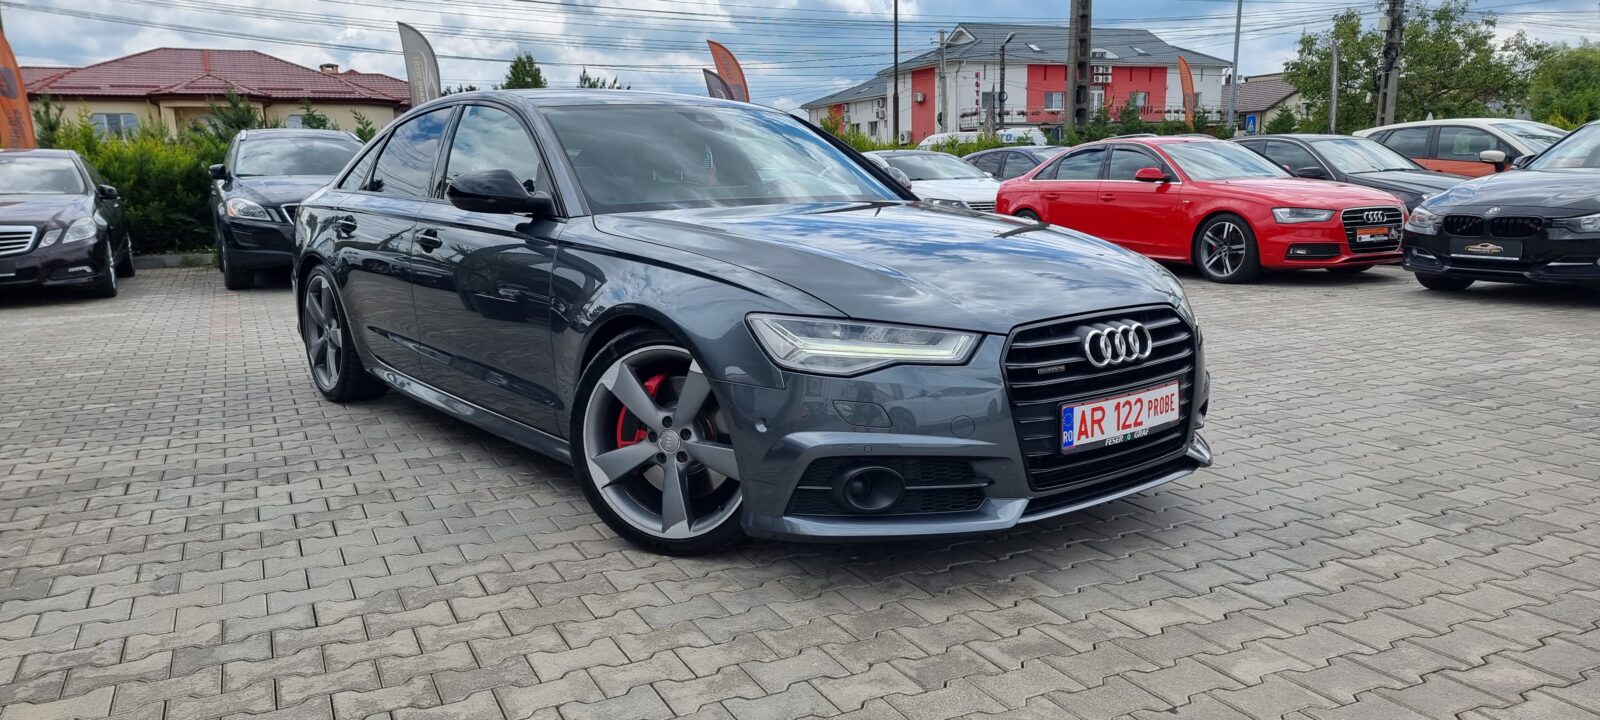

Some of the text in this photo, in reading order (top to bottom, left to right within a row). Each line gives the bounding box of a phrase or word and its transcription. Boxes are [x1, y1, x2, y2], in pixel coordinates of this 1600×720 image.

[1077, 393, 1175, 441] AR 122 PROBE
[1063, 430, 1073, 443] RO
[1105, 428, 1149, 446] FESER GRAF
